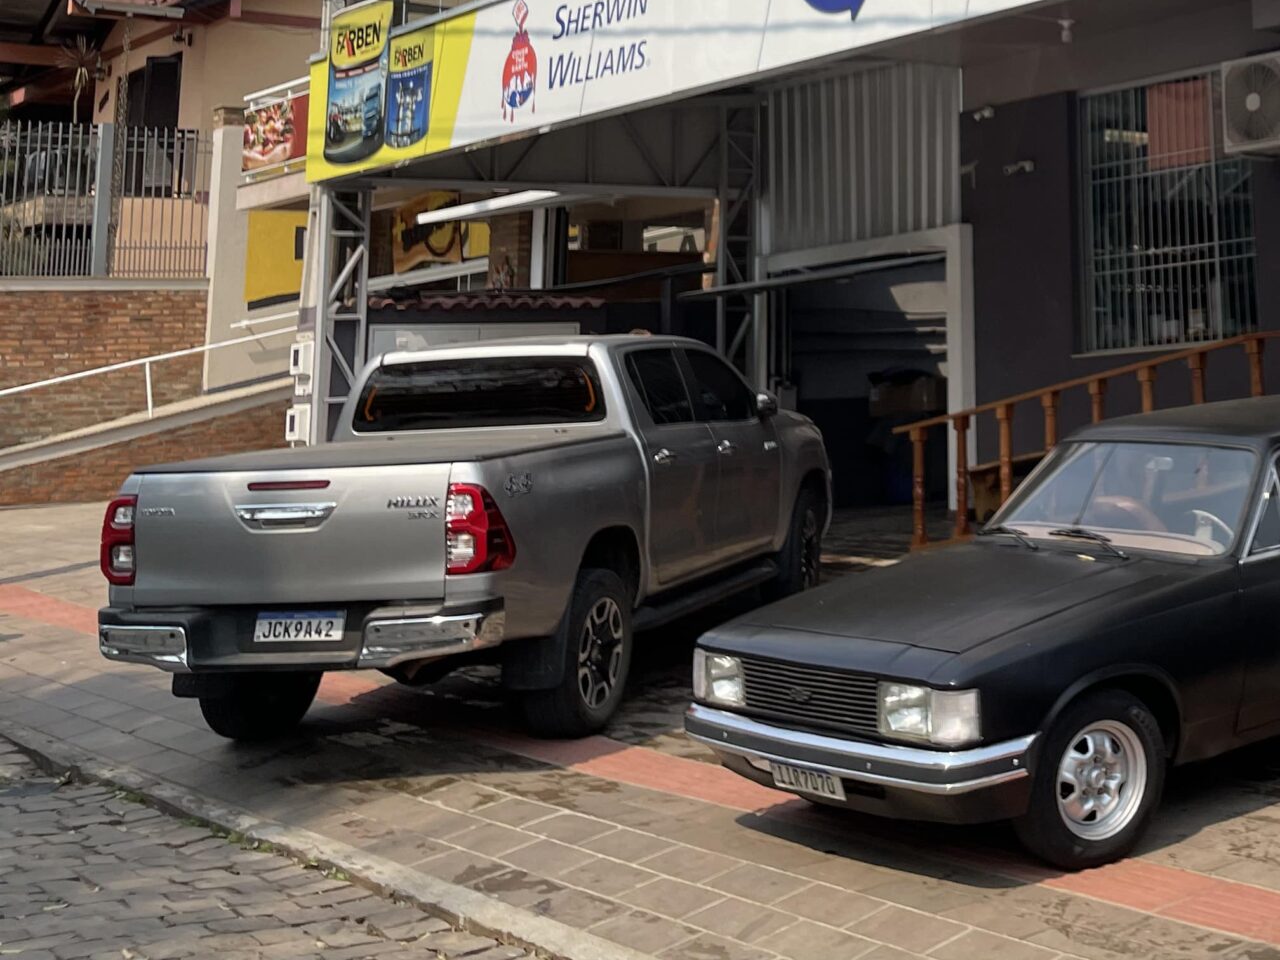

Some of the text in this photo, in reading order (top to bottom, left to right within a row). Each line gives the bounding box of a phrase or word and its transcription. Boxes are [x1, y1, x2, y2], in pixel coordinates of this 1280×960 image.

[336, 20, 381, 58] FARBEN
[394, 43, 424, 68] FARBEN
[548, 40, 647, 90] WILLIAMS
[386, 495, 441, 510] HILUX
[262, 620, 334, 639] JCK9A42
